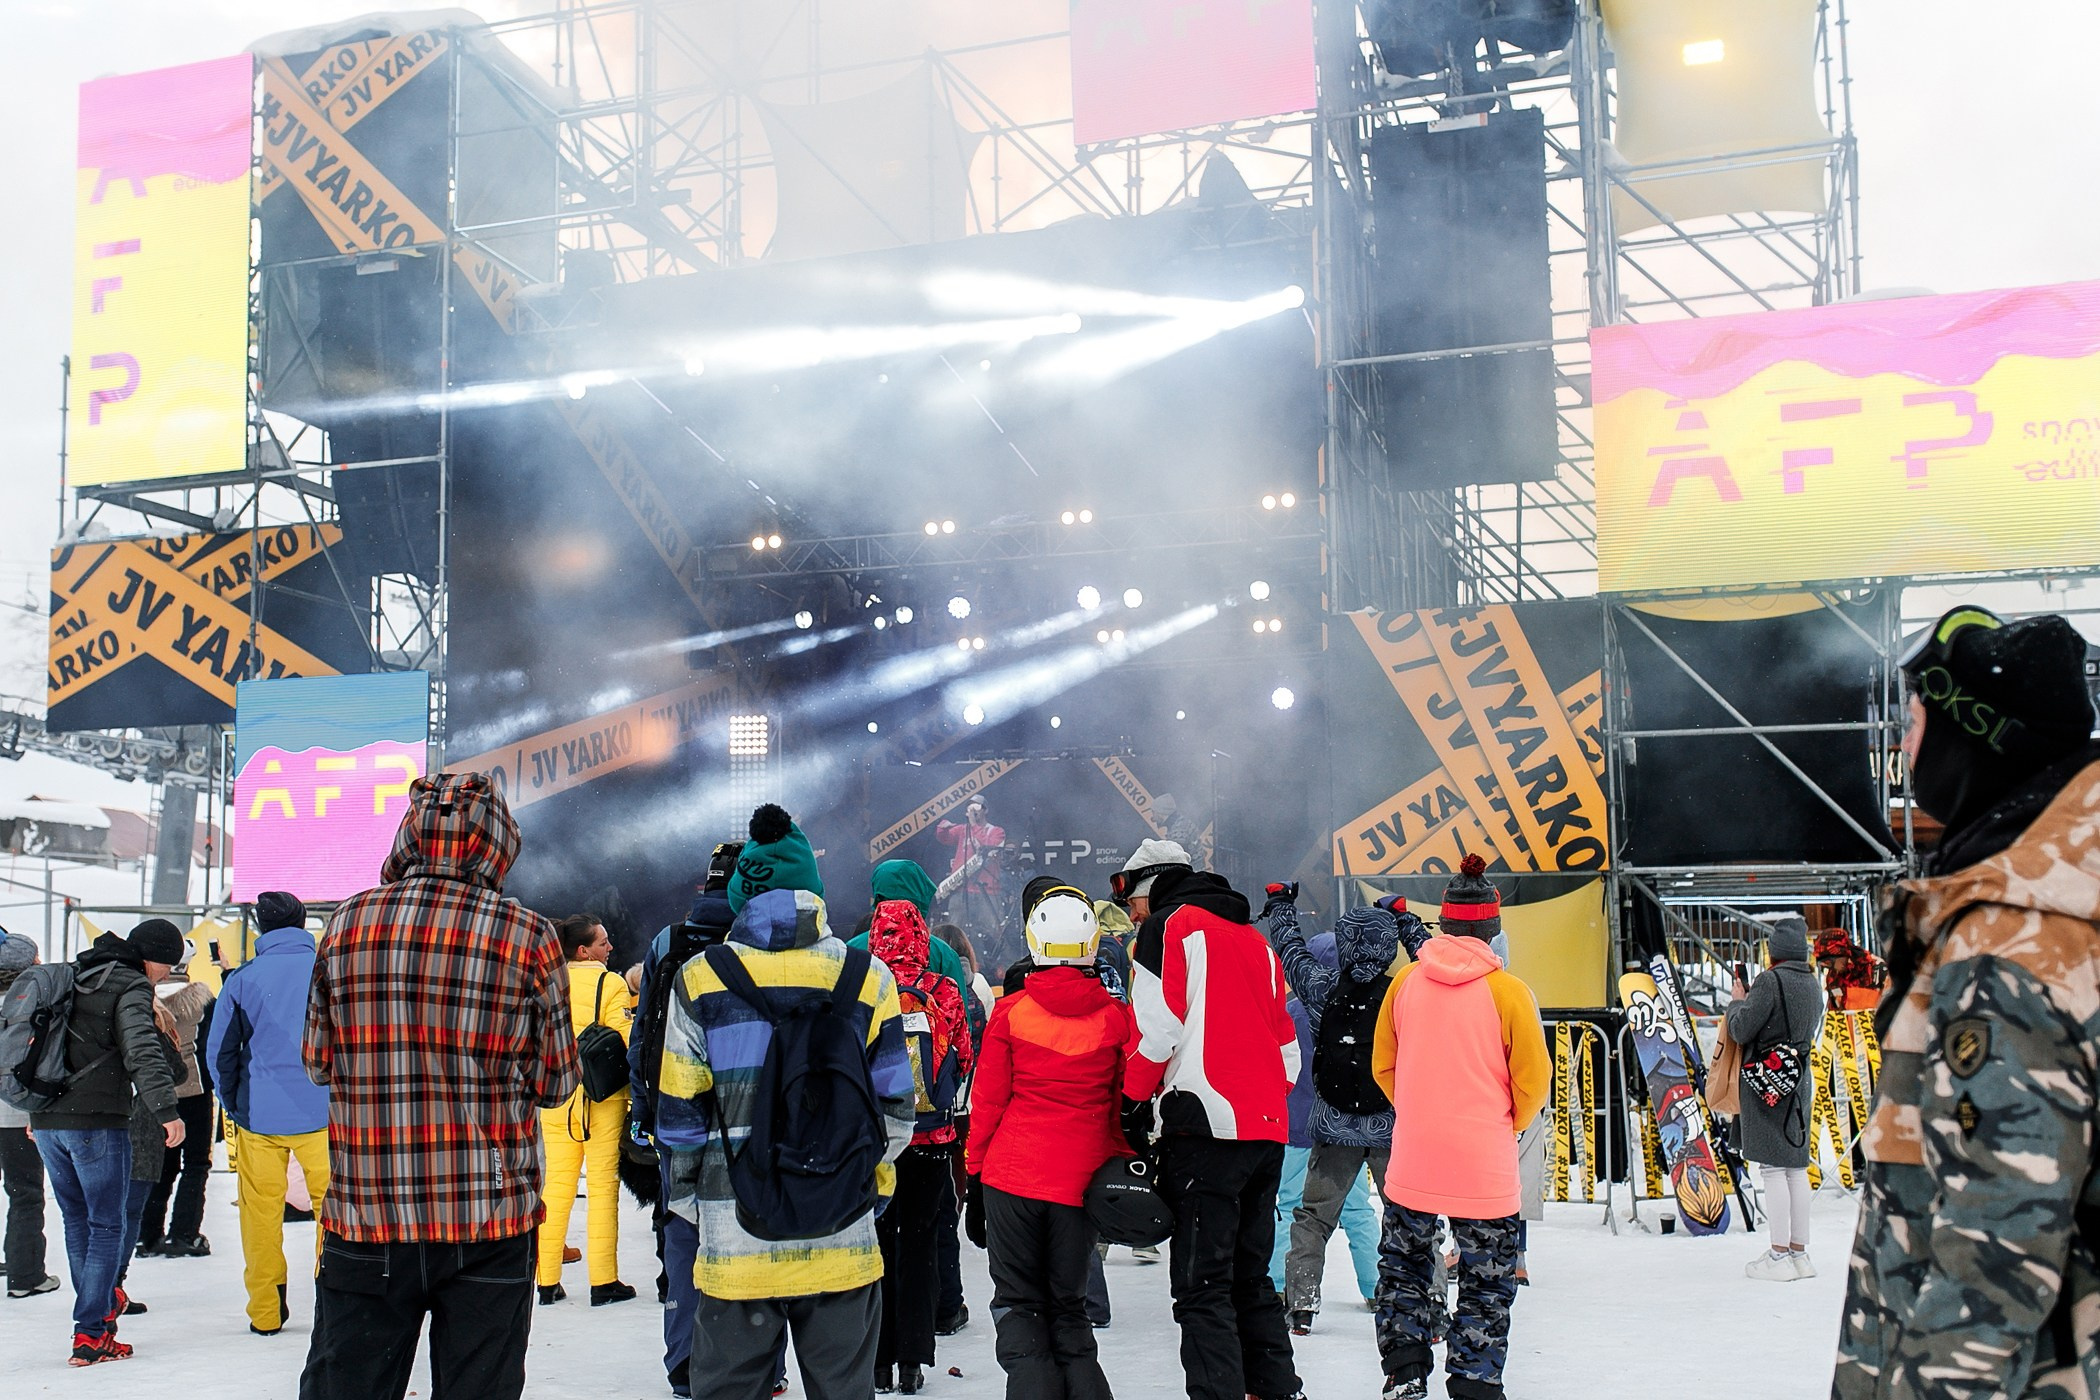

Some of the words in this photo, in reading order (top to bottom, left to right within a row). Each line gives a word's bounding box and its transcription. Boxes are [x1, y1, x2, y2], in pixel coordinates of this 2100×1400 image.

[340, 76, 372, 117] JV
[108, 567, 176, 631] JV
[530, 747, 558, 789] JV
[563, 720, 633, 776] YARKO
[1431, 607, 1607, 871] #JVYARKO
[249, 753, 419, 819] AFP
[1111, 766, 1147, 807] YARKO
[872, 823, 913, 855] YARKO
[1359, 811, 1407, 862] JV
[1407, 784, 1468, 830] YA
[1018, 839, 1092, 865] AFP
[1096, 846, 1118, 856] snow
[1096, 856, 1127, 865] edition
[1557, 1054, 1568, 1135] #JVYARKO
[492, 1147, 504, 1189] ICEPEAK
[1129, 1185, 1151, 1193] BLACK
